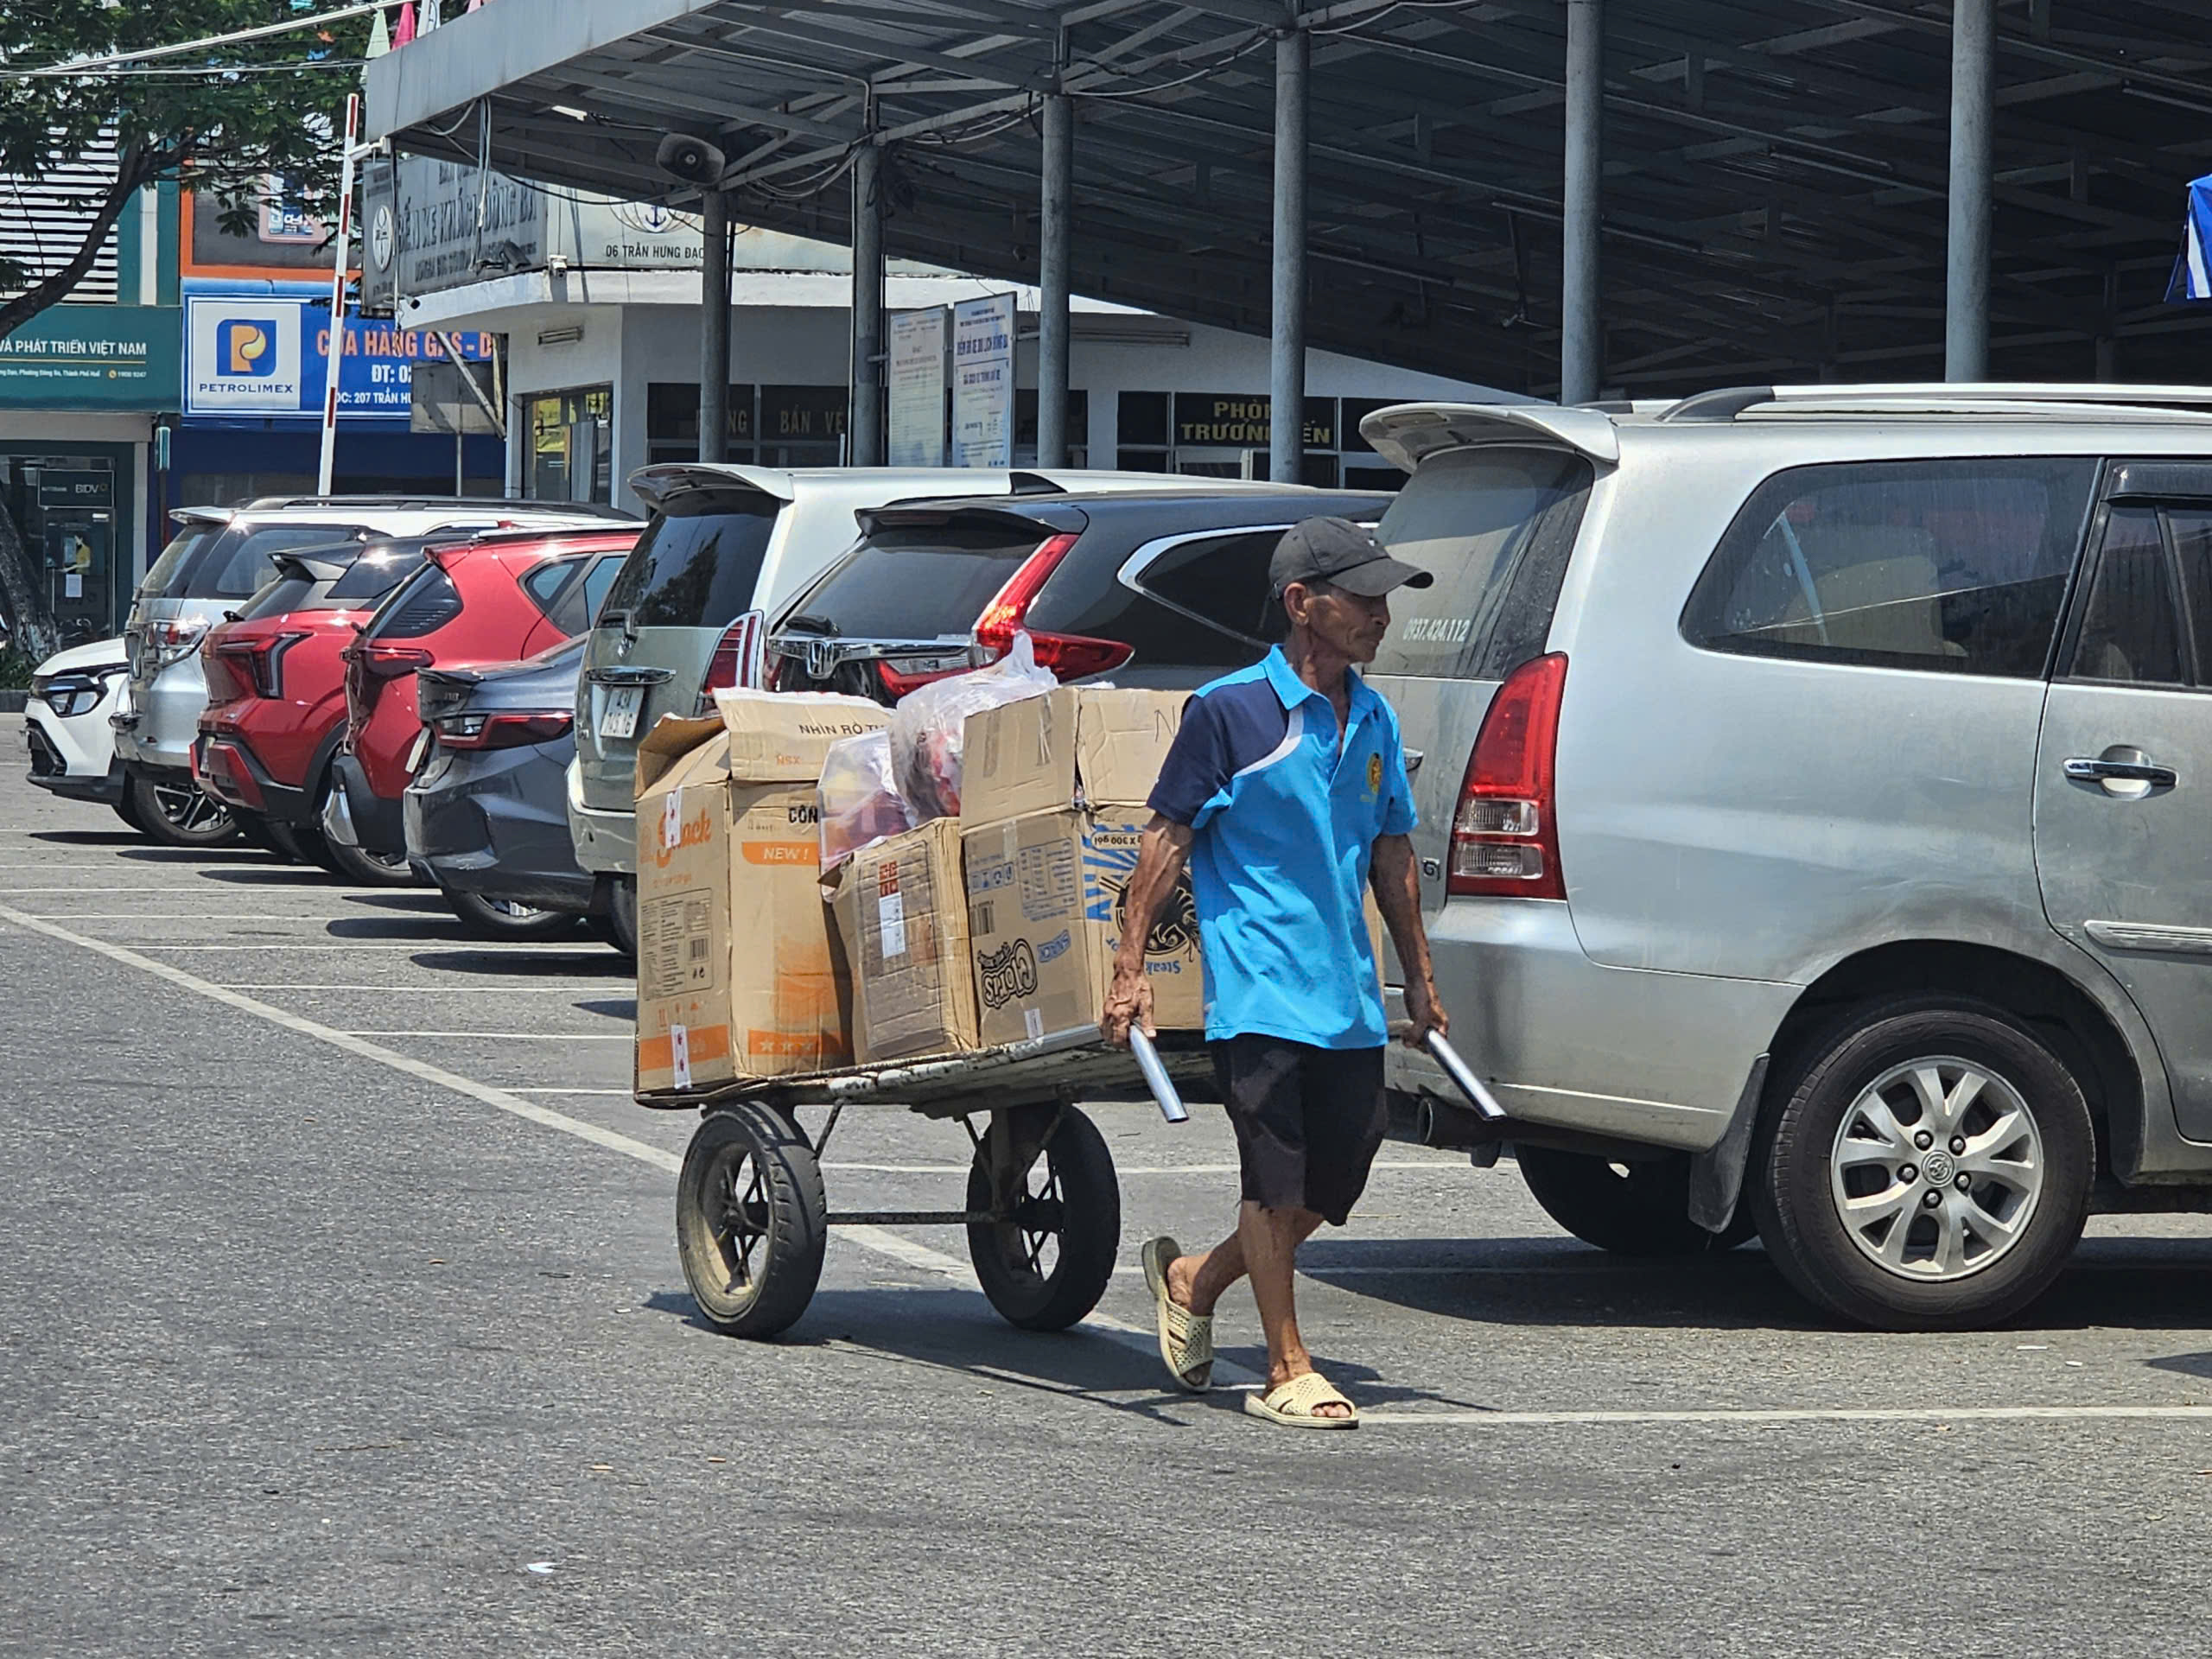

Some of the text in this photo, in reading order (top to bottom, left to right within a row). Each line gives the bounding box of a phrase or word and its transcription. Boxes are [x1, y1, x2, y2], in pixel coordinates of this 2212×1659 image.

[606, 245, 619, 257] 06
[652, 245, 681, 258] HƯNG
[15, 338, 48, 353] PHÁT
[88, 340, 117, 357] VIỆT
[118, 342, 147, 356] NAM
[200, 383, 293, 393] PETROLIMEX
[353, 391, 372, 404] 207
